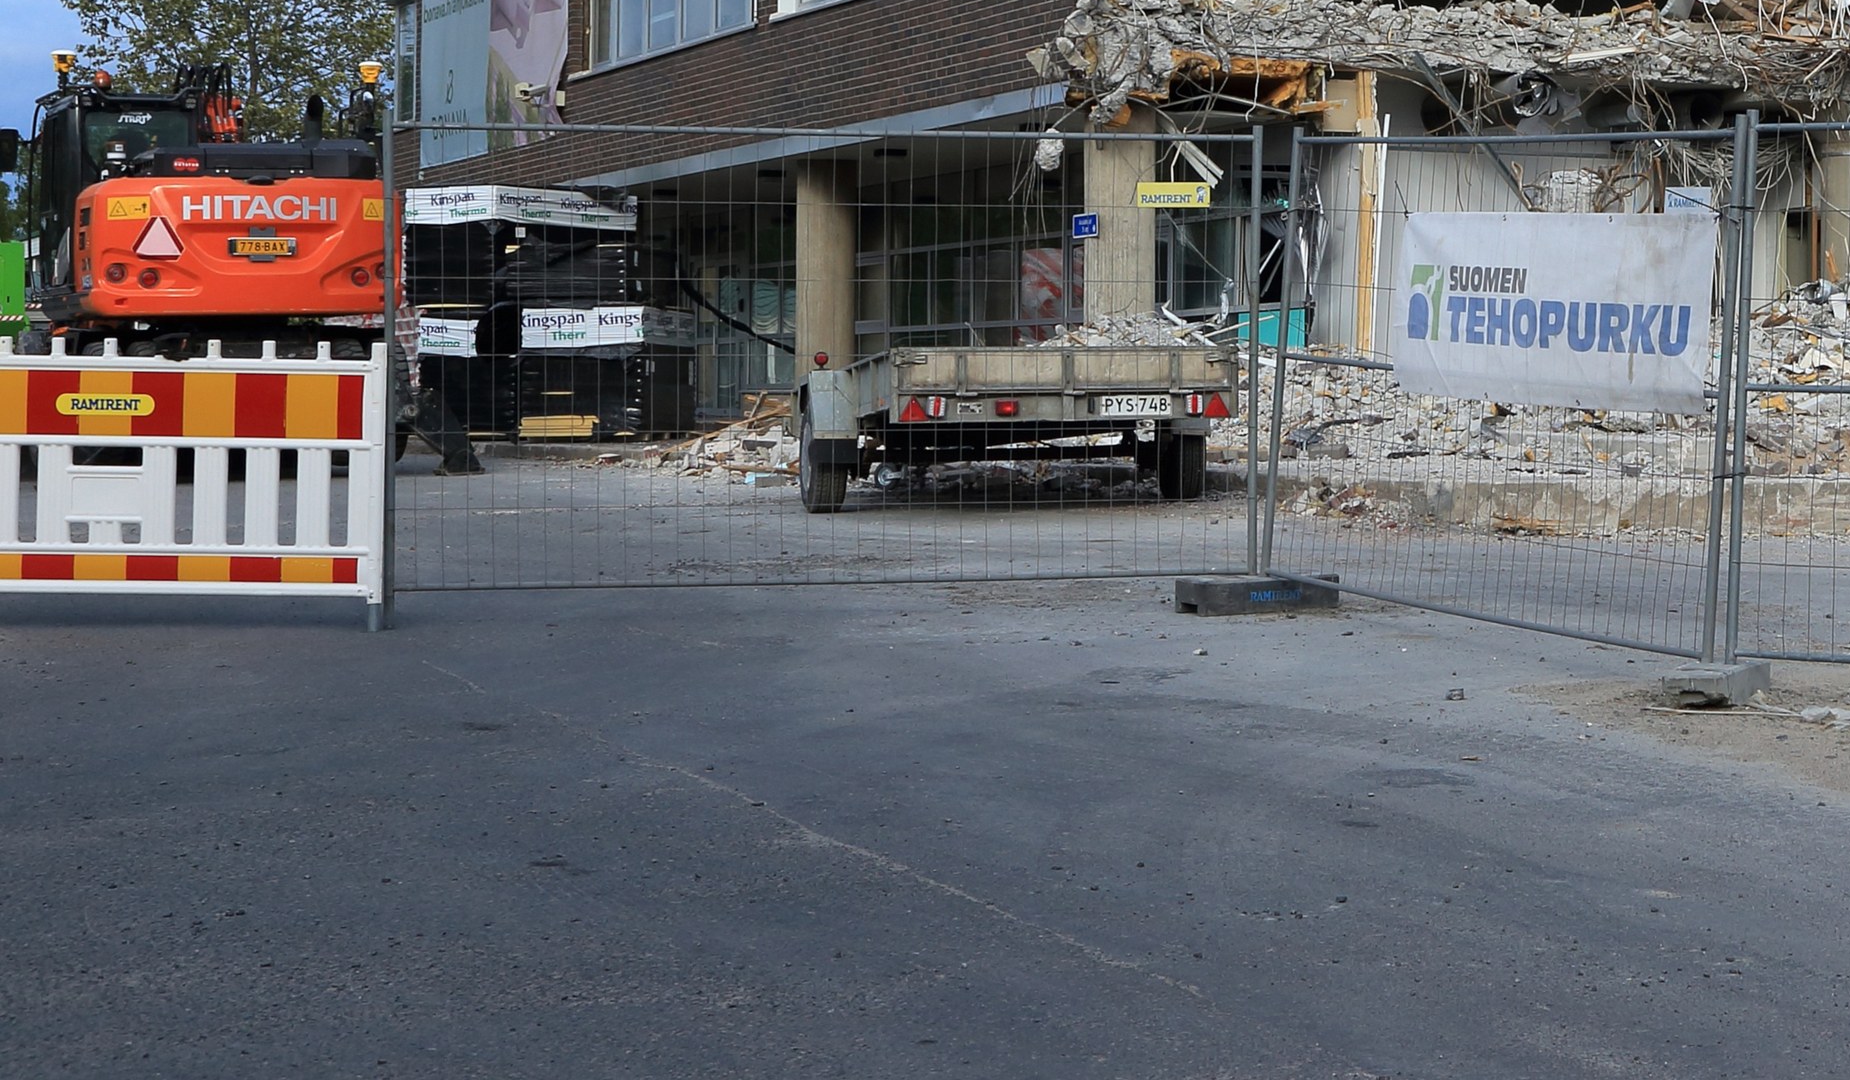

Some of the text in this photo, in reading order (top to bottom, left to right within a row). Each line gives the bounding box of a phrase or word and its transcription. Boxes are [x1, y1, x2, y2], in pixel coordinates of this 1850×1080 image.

[431, 108, 467, 140] BONAVA
[182, 195, 337, 221] HITACHI
[1141, 194, 1192, 204] RAMIRENT
[240, 241, 286, 252] 778-BAX
[1449, 265, 1527, 294] SUOMEN
[1447, 296, 1691, 356] TEHOPURKU
[71, 399, 141, 411] RAMIRENT
[1105, 398, 1168, 412] PYS-748
